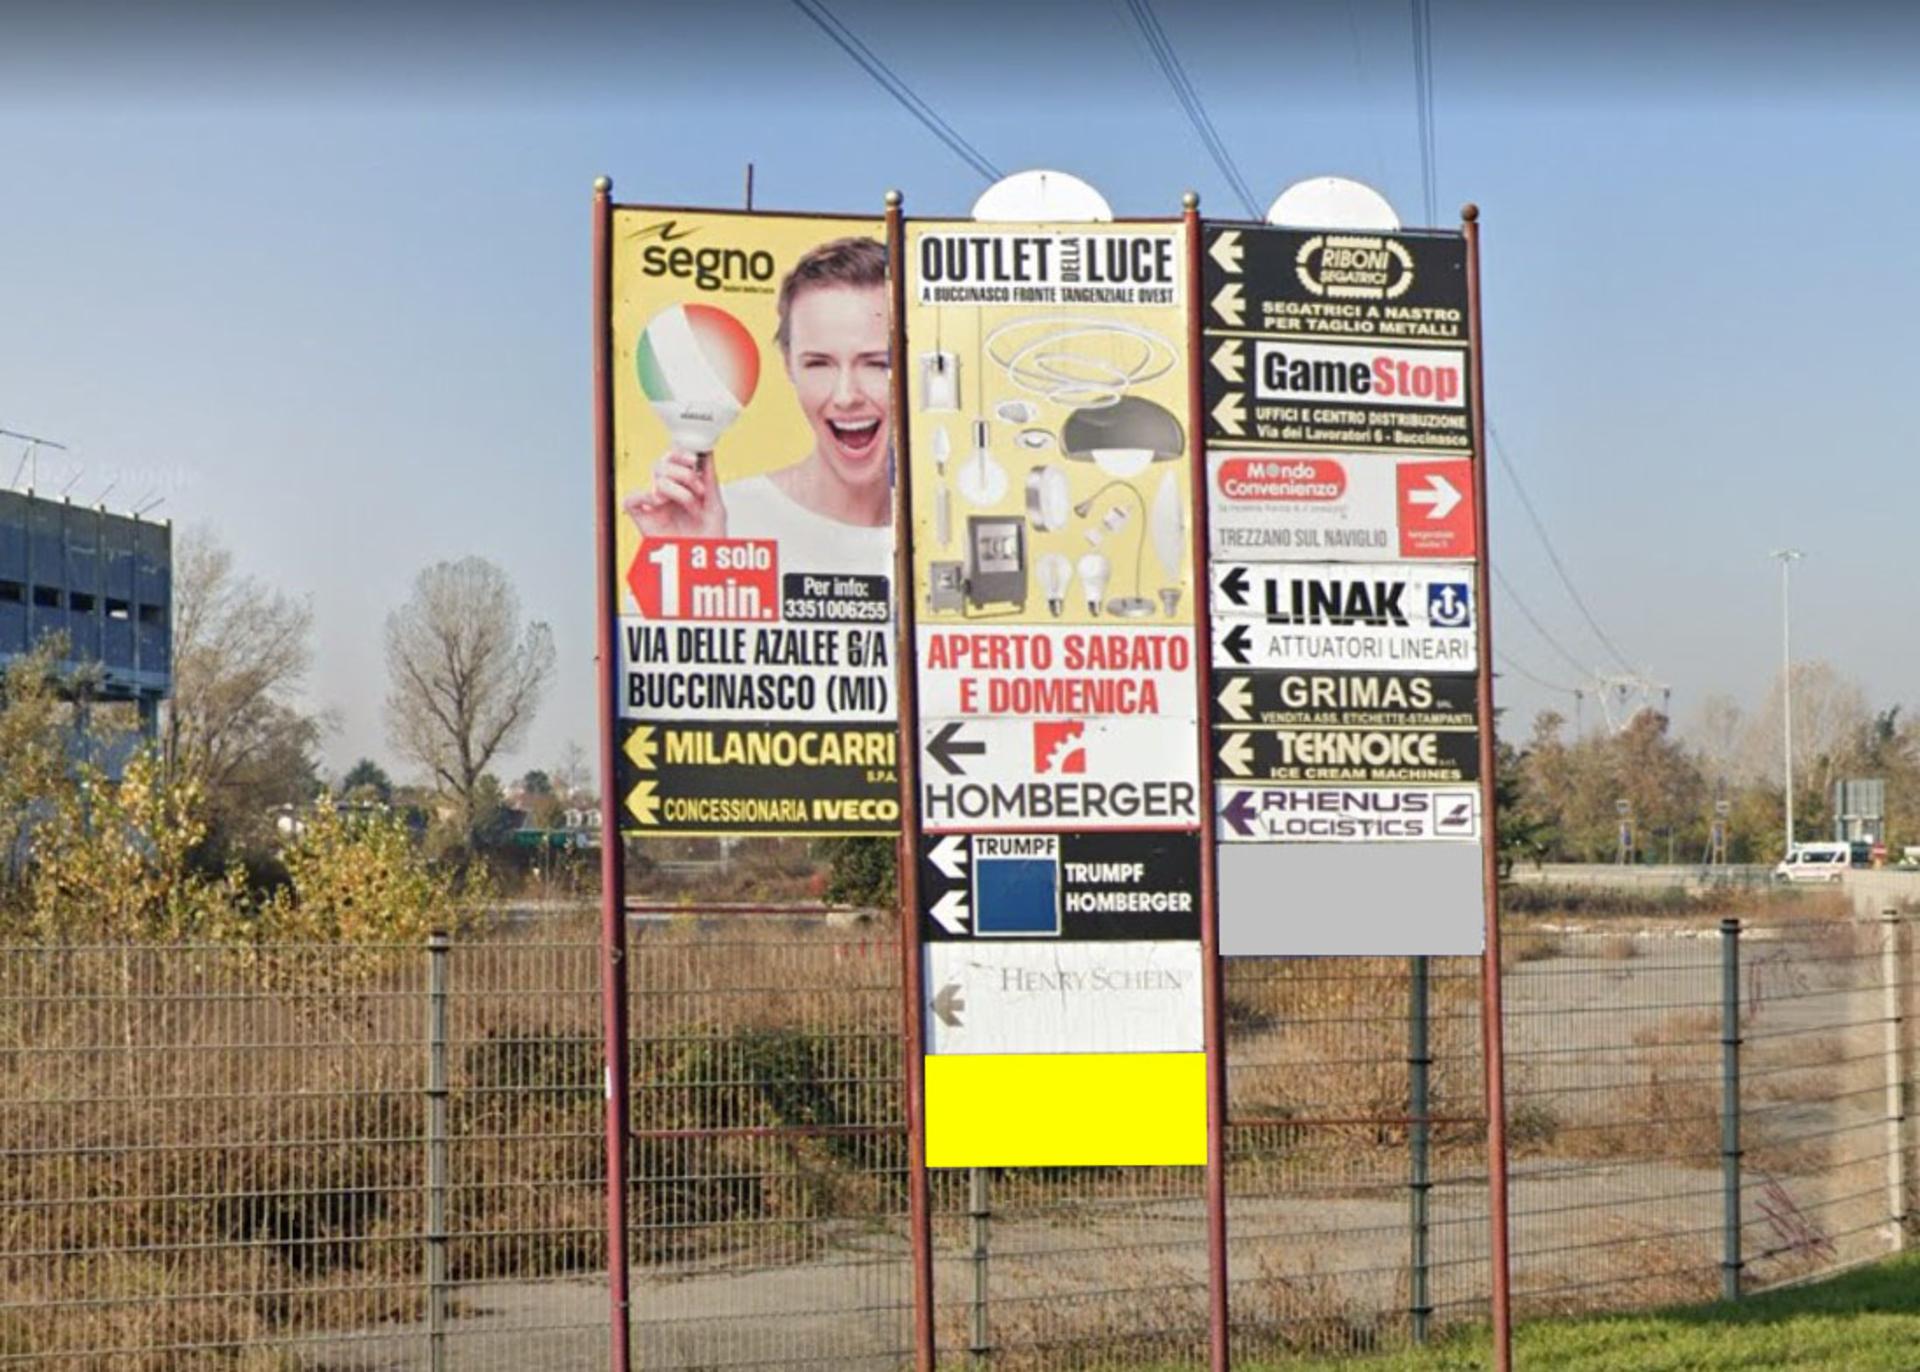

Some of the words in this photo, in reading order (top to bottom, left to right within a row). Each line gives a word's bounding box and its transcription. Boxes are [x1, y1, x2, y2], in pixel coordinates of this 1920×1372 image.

[643, 245, 774, 291] segno
[921, 237, 1052, 282] OUTLET
[1060, 237, 1081, 283] DELLA
[1086, 238, 1172, 283] LUCE
[1321, 249, 1389, 270] RIBONI
[922, 287, 931, 301] A
[935, 287, 1009, 302] BUCCINASCO
[1013, 287, 1056, 302] FRONTE
[1061, 288, 1134, 303] TANGENZIALE
[1139, 288, 1173, 303] OVEST
[1262, 301, 1362, 317] SEGATRICI
[1367, 305, 1380, 318] A
[1385, 306, 1461, 322] NASTRO
[1264, 317, 1300, 330] PER
[1306, 318, 1374, 333] TAGLIO
[1379, 322, 1458, 336] METALLI
[1263, 351, 1458, 402] GameStop
[1255, 406, 1298, 421] UFFICI
[1302, 408, 1310, 422] E
[1313, 409, 1366, 425] CENTRO
[1369, 412, 1467, 429] DISTRIBUZIONE
[1256, 425, 1279, 438] Via
[1306, 427, 1371, 442] Lavoratori
[1394, 430, 1468, 446] Buccinasco
[1225, 479, 1338, 497] Convenienza
[1219, 528, 1292, 547] TREZZANO
[1294, 528, 1321, 548] SUL
[1324, 528, 1387, 548] NAVIGLIO
[692, 546, 707, 569] a
[715, 543, 771, 570] solo
[649, 543, 680, 618] 1
[803, 577, 830, 597] Per
[834, 577, 869, 598] info:
[692, 579, 773, 619] min.
[785, 600, 888, 620] 3351006255
[1265, 579, 1409, 627] LINAK
[627, 627, 669, 663] VIA
[677, 627, 746, 665] DELLE
[754, 629, 839, 666] AZALEE
[847, 631, 888, 667] 6/A
[928, 634, 1053, 671] APERTO
[1064, 634, 1189, 672] SABATO
[1268, 635, 1384, 658] ATTUATORI
[1390, 637, 1469, 660] LINEARI
[628, 672, 815, 710] BUCCINASCO
[827, 675, 888, 713] (MI)
[960, 678, 978, 713] E
[989, 678, 1159, 715] DOMENICA
[1280, 676, 1433, 708] GRIMAS
[1261, 712, 1312, 724] VENDITA
[665, 730, 896, 766] MILANOCARRI
[1277, 731, 1437, 766] TEKNOICE
[1270, 767, 1300, 779] ICE
[1305, 767, 1367, 779] CREAM
[1371, 768, 1462, 780] MACHINES
[664, 798, 808, 822] CONCESSIONARIA
[813, 799, 899, 822] IVECO
[925, 782, 1195, 819] HOMBERGER
[1262, 791, 1429, 812] RHENUS
[1268, 818, 1424, 837] LOGISTICS
[975, 838, 1056, 856] TRUMPF
[1064, 863, 1145, 883] TRUMPF
[1065, 892, 1193, 913] HOMBERGER
